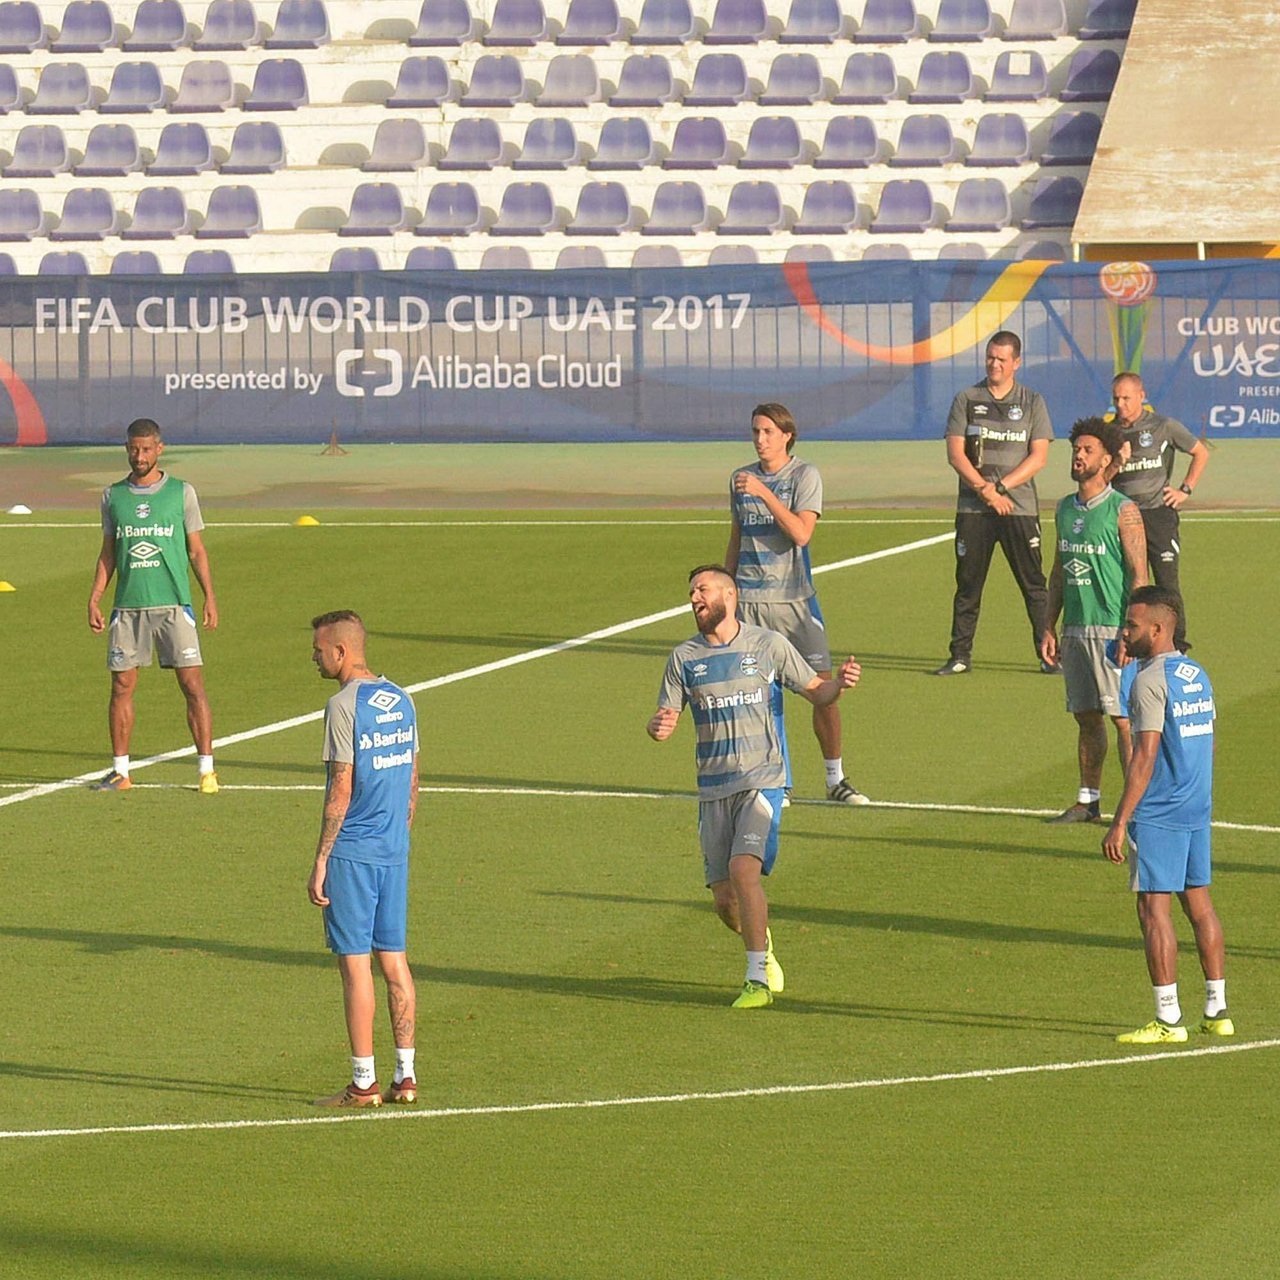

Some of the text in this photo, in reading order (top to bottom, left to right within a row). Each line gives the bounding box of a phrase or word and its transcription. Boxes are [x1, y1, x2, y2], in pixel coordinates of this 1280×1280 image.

[35, 293, 751, 335] FIFA CLUB WORLD CUP UAE 2017
[1177, 317, 1239, 336] CLUB
[165, 354, 622, 395] presented by Alibaba Cloud
[129, 559, 160, 569] umbro
[706, 687, 763, 710] Banrisul
